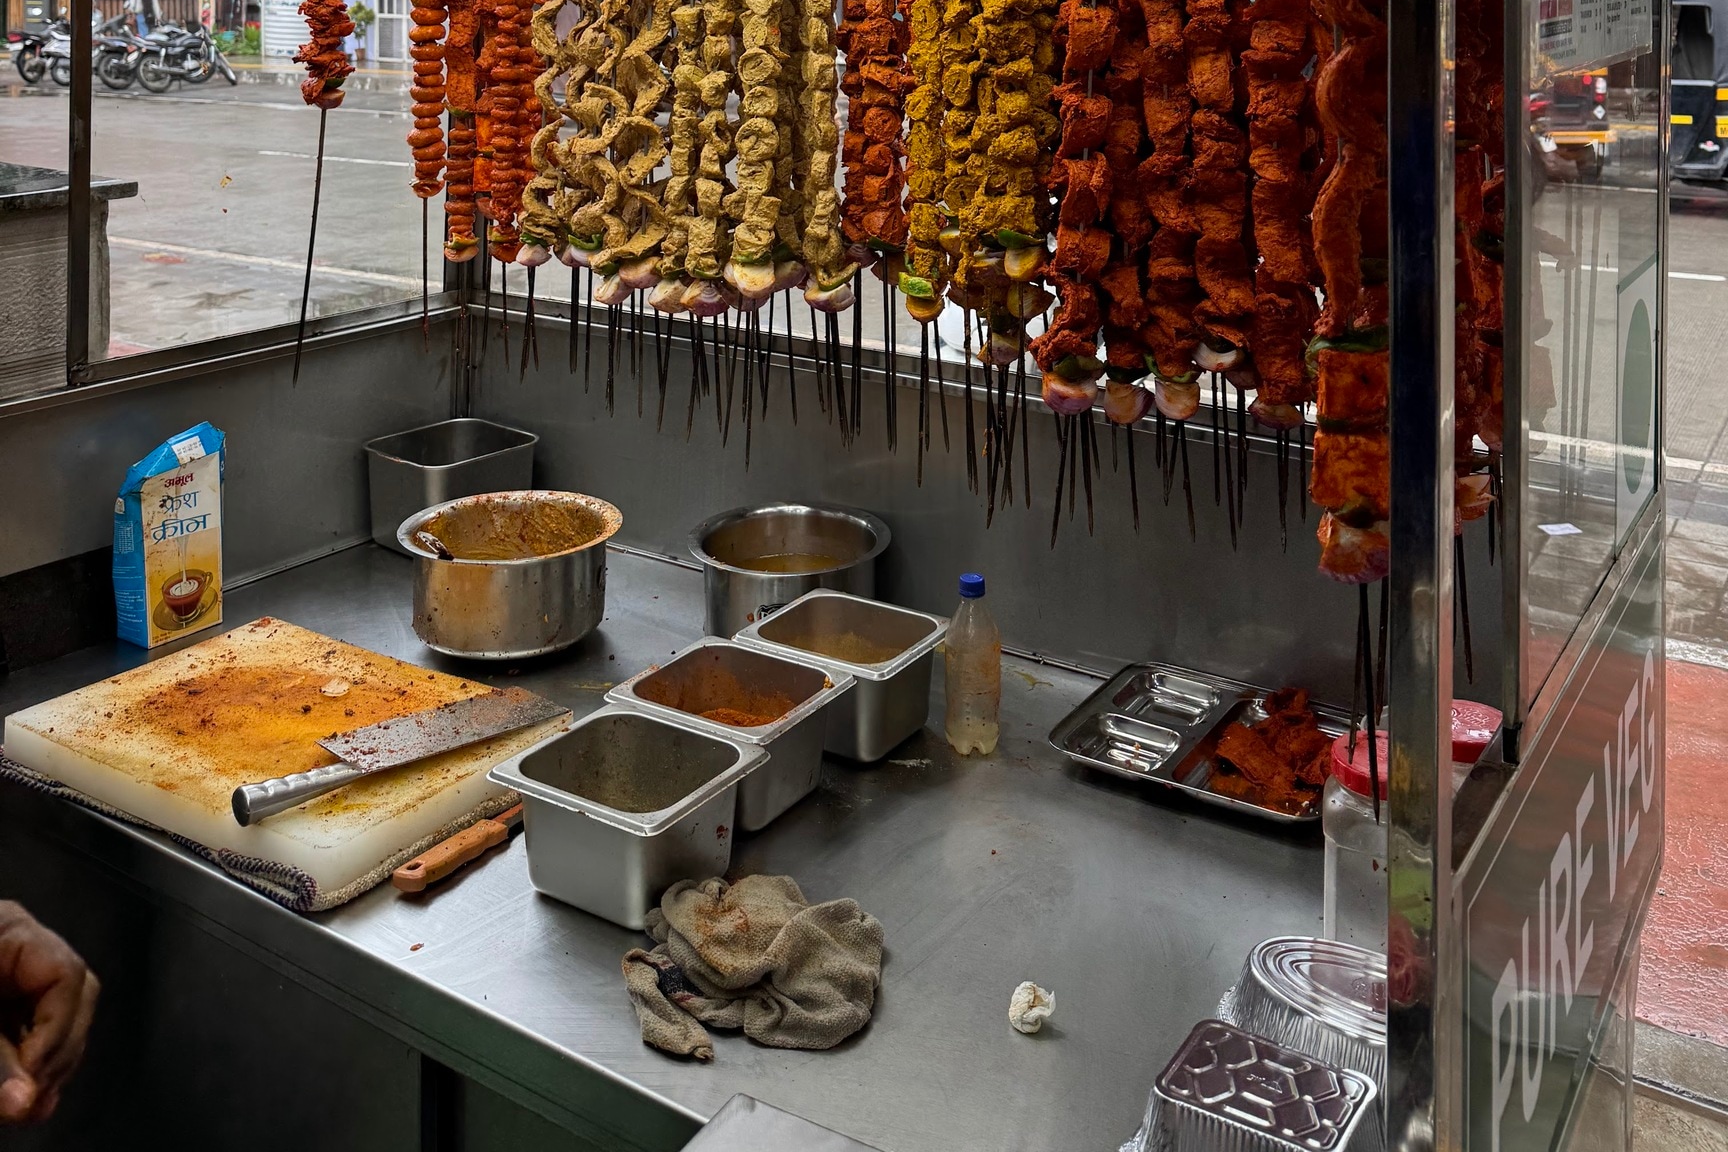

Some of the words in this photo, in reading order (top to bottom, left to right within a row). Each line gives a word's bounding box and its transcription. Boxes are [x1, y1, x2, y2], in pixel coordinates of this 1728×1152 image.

[164, 472, 195, 488] अमूल
[160, 491, 201, 515] फ्रेश
[151, 513, 212, 545] क्रीम
[1492, 772, 1595, 1152] PURE
[1604, 650, 1656, 903] VEG
